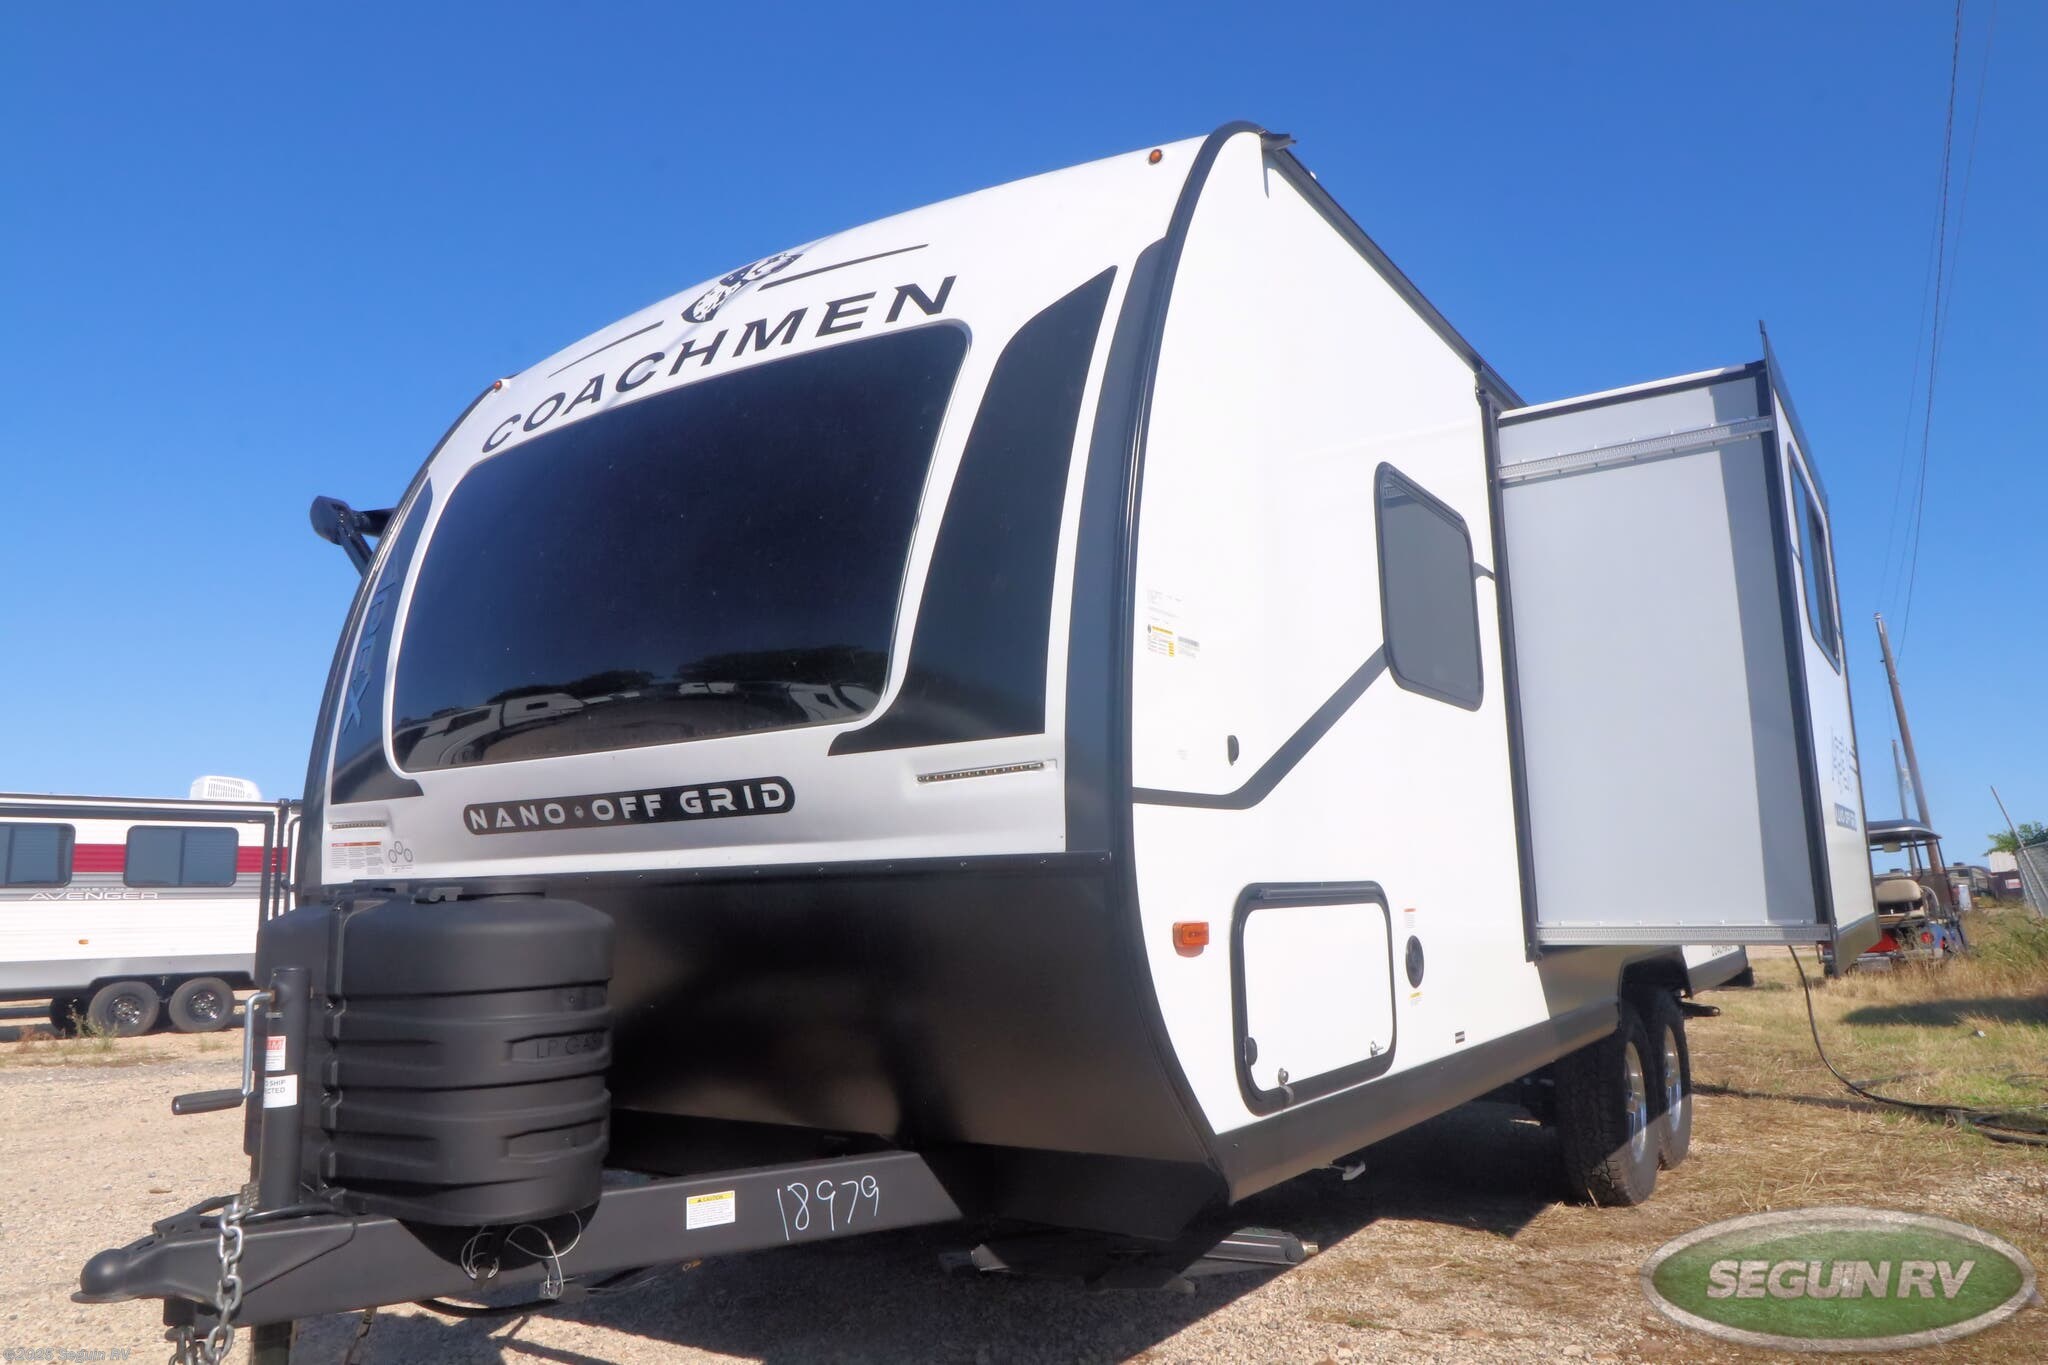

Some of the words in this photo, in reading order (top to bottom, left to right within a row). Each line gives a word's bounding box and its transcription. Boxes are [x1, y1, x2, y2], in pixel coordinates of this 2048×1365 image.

[481, 275, 957, 454] COACHMEN
[468, 803, 566, 831] NANO
[591, 794, 662, 821] OFF
[679, 782, 786, 814] GRID
[30, 892, 158, 900] AVENGER
[776, 1175, 880, 1241] 18979
